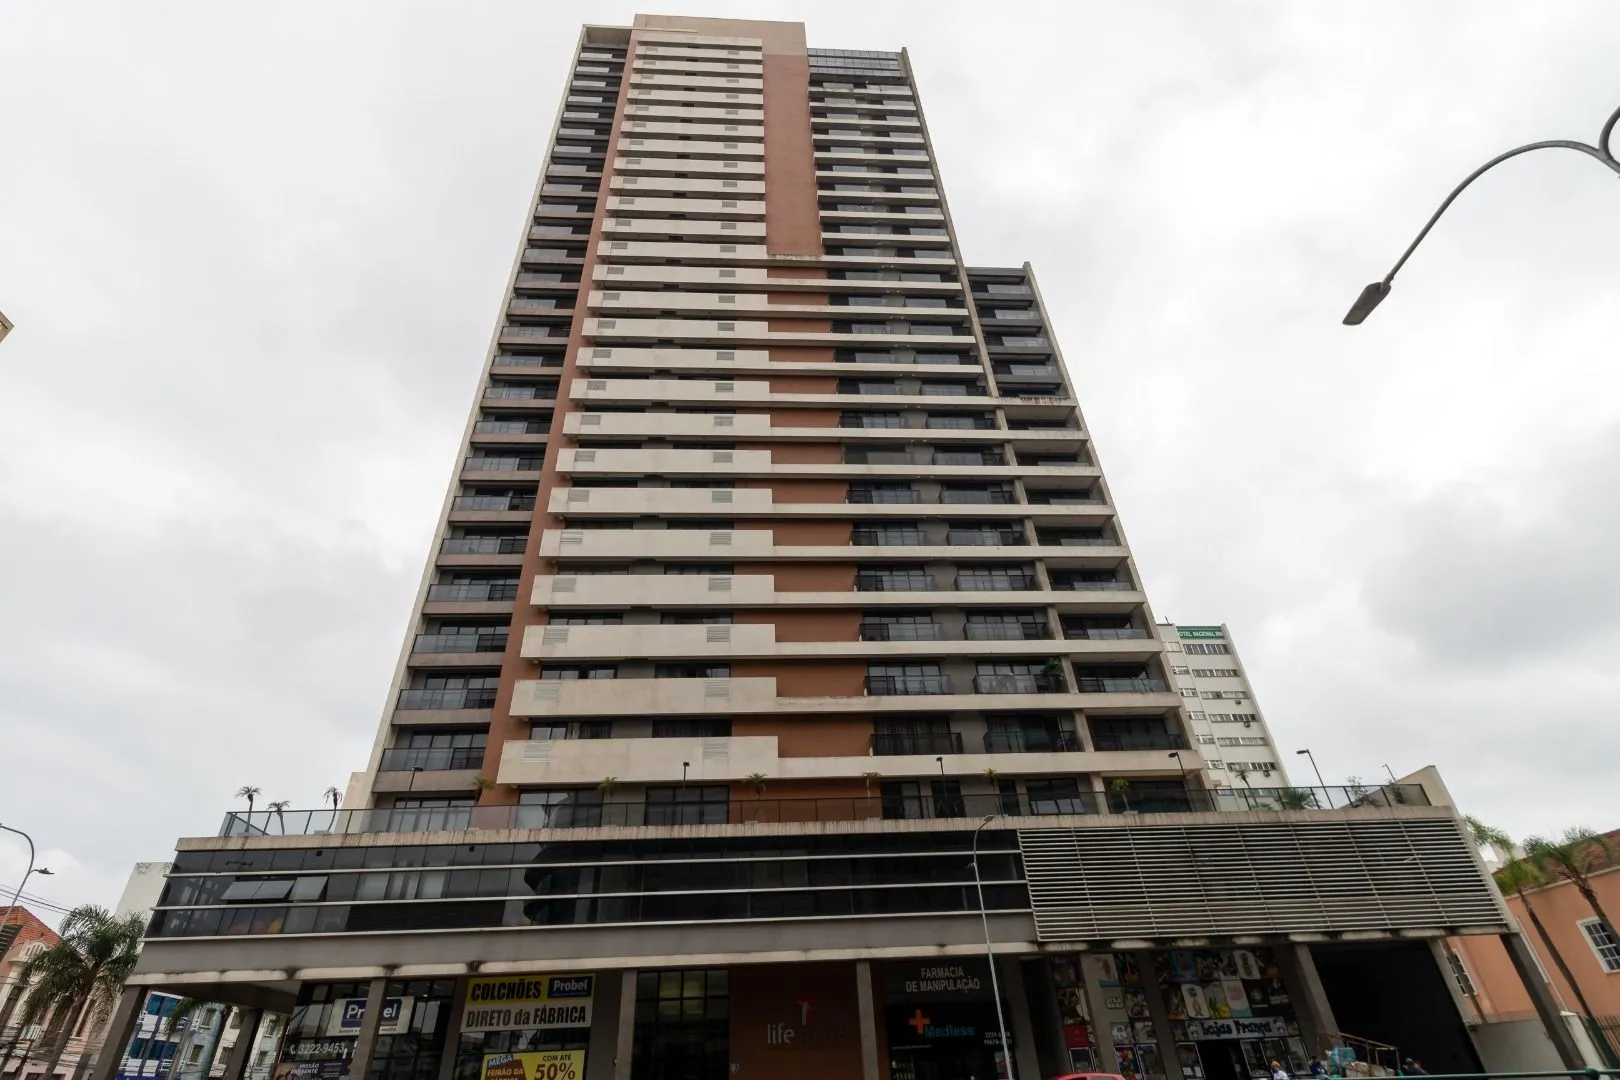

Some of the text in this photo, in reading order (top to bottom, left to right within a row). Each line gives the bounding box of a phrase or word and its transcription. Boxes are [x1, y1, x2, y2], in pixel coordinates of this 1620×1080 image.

[920, 964, 965, 978] FARMÁCIA
[471, 978, 588, 1001] COLCHÕES Probel
[905, 977, 980, 993] DE MANIPULAÇÃO
[465, 1004, 586, 1028] DIRETO da FÁBRICA
[767, 1023, 795, 1044] life
[297, 1042, 345, 1055] 3222-9453
[488, 1054, 513, 1067] MEGA
[534, 1062, 576, 1080] 50%
